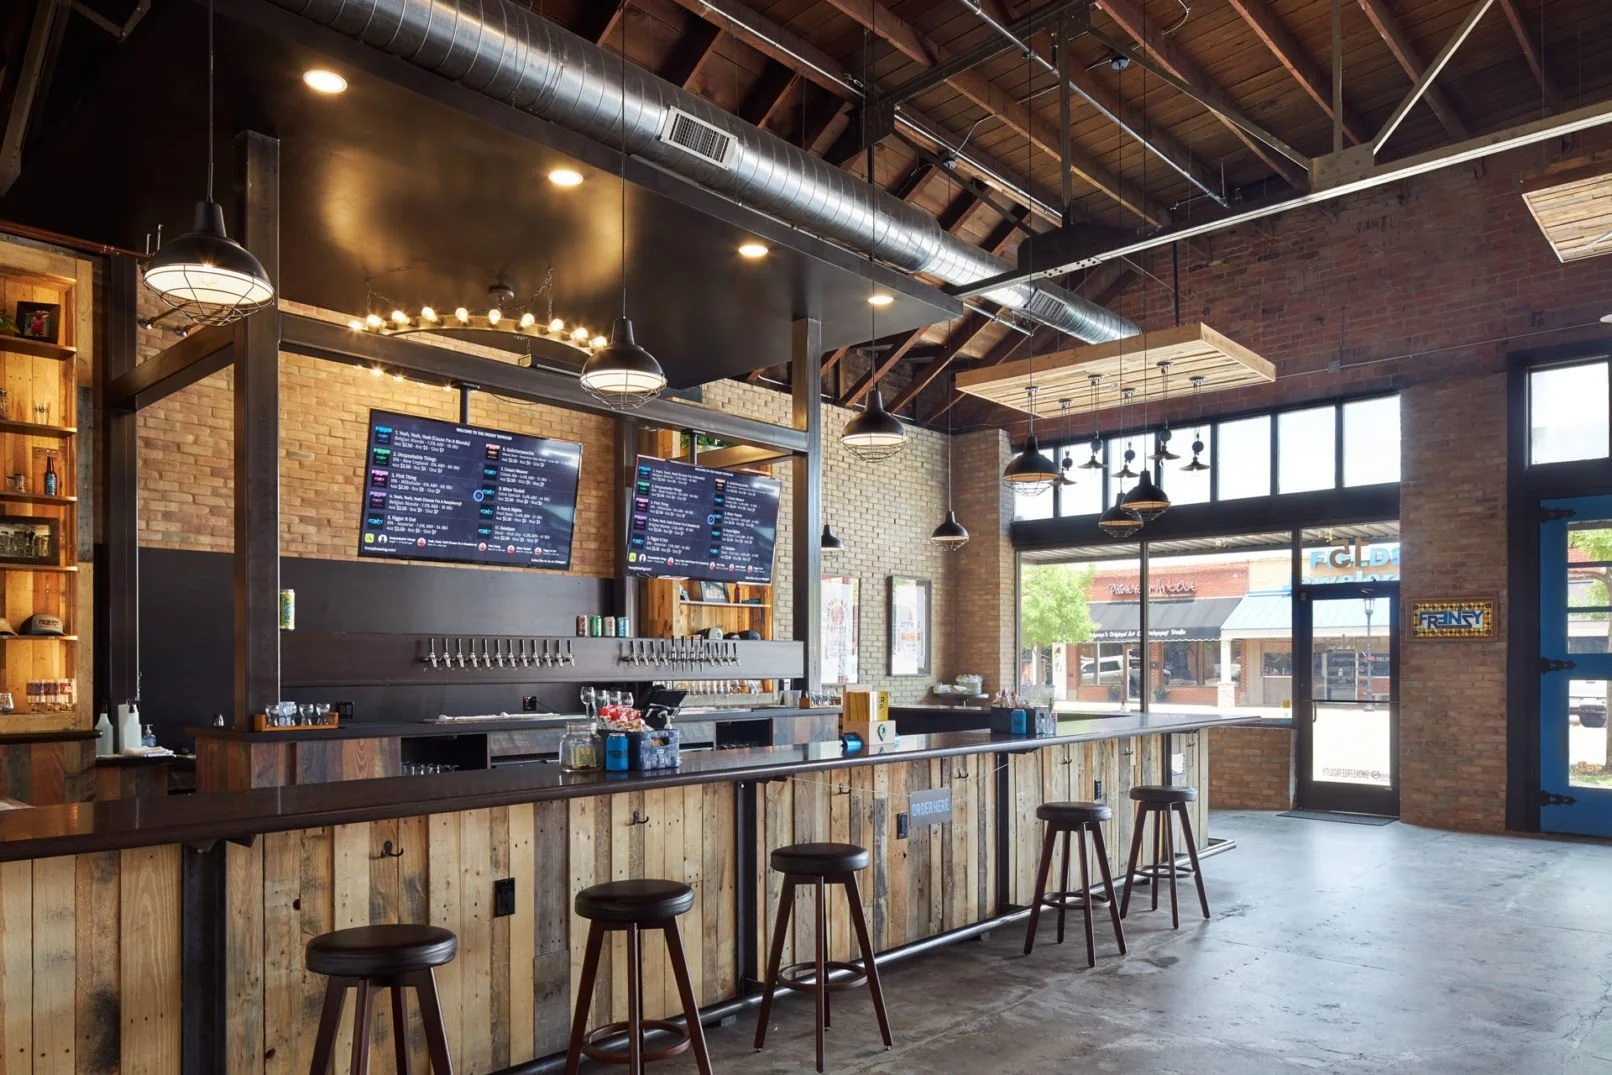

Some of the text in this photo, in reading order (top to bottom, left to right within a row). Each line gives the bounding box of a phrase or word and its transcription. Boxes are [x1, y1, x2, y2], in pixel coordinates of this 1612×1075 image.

[1109, 584, 1132, 594] Paint
[1133, 584, 1151, 594] Yor
[1177, 579, 1197, 592] Out
[912, 798, 950, 816] ORDER HERE
